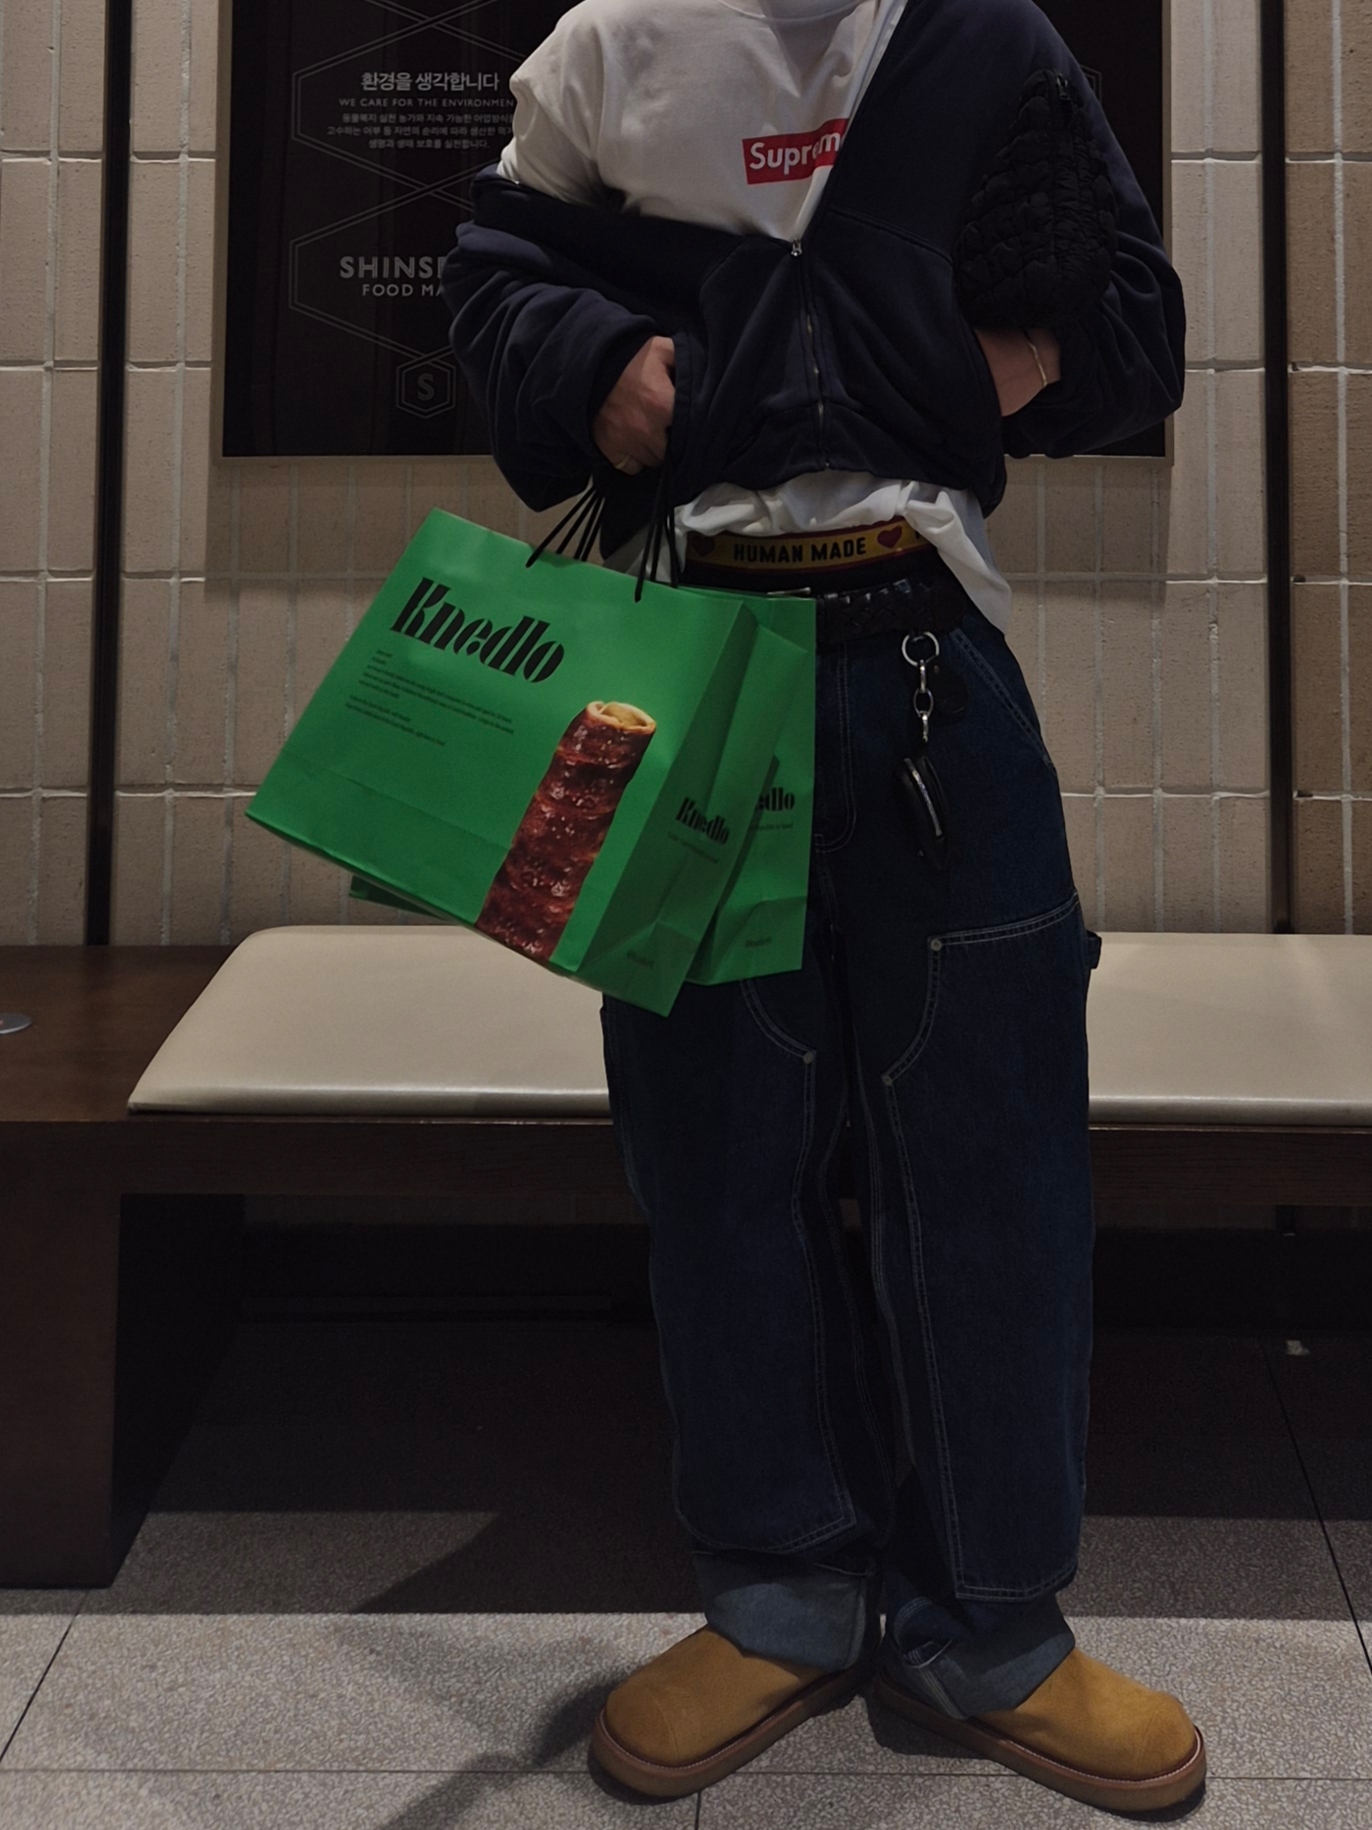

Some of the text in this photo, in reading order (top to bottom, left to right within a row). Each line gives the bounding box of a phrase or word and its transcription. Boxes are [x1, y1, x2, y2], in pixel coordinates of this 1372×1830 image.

[360, 71, 500, 92] 환경을 생각합니다
[339, 98, 514, 107] WE CARE FOR THE ENVIRONMEN
[426, 113, 444, 123] 지속
[446, 113, 472, 123] 가능한
[749, 131, 842, 176] Suprem
[339, 255, 446, 279] SHINSE
[362, 283, 414, 297] FOOD
[416, 373, 435, 401] S
[733, 537, 867, 563] HUMAN MADE
[390, 577, 565, 684] Knedlo
[755, 787, 796, 811] edlo
[675, 797, 730, 845] Knedlo
